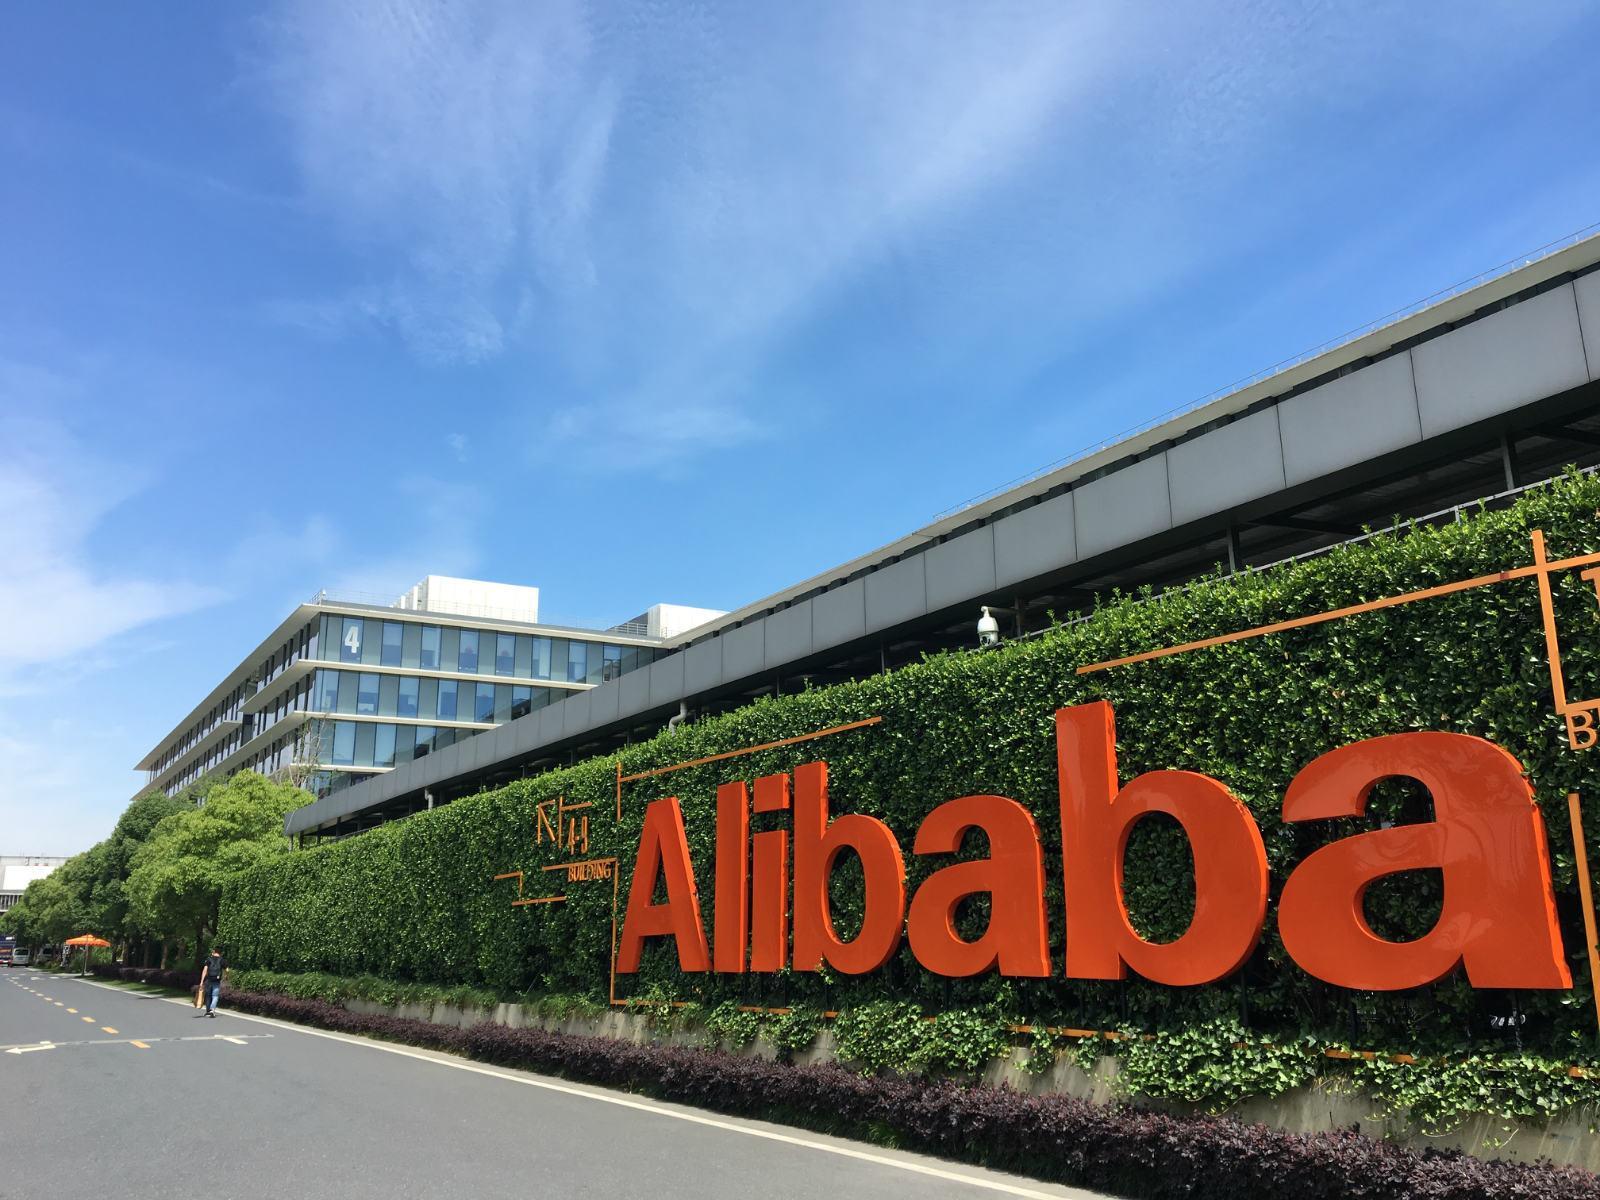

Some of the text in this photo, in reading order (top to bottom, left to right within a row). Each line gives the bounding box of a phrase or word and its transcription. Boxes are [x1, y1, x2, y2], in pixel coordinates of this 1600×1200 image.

[344, 626, 360, 654] 4
[615, 700, 1573, 991] Alibaba
[567, 861, 612, 883] BUILDING
